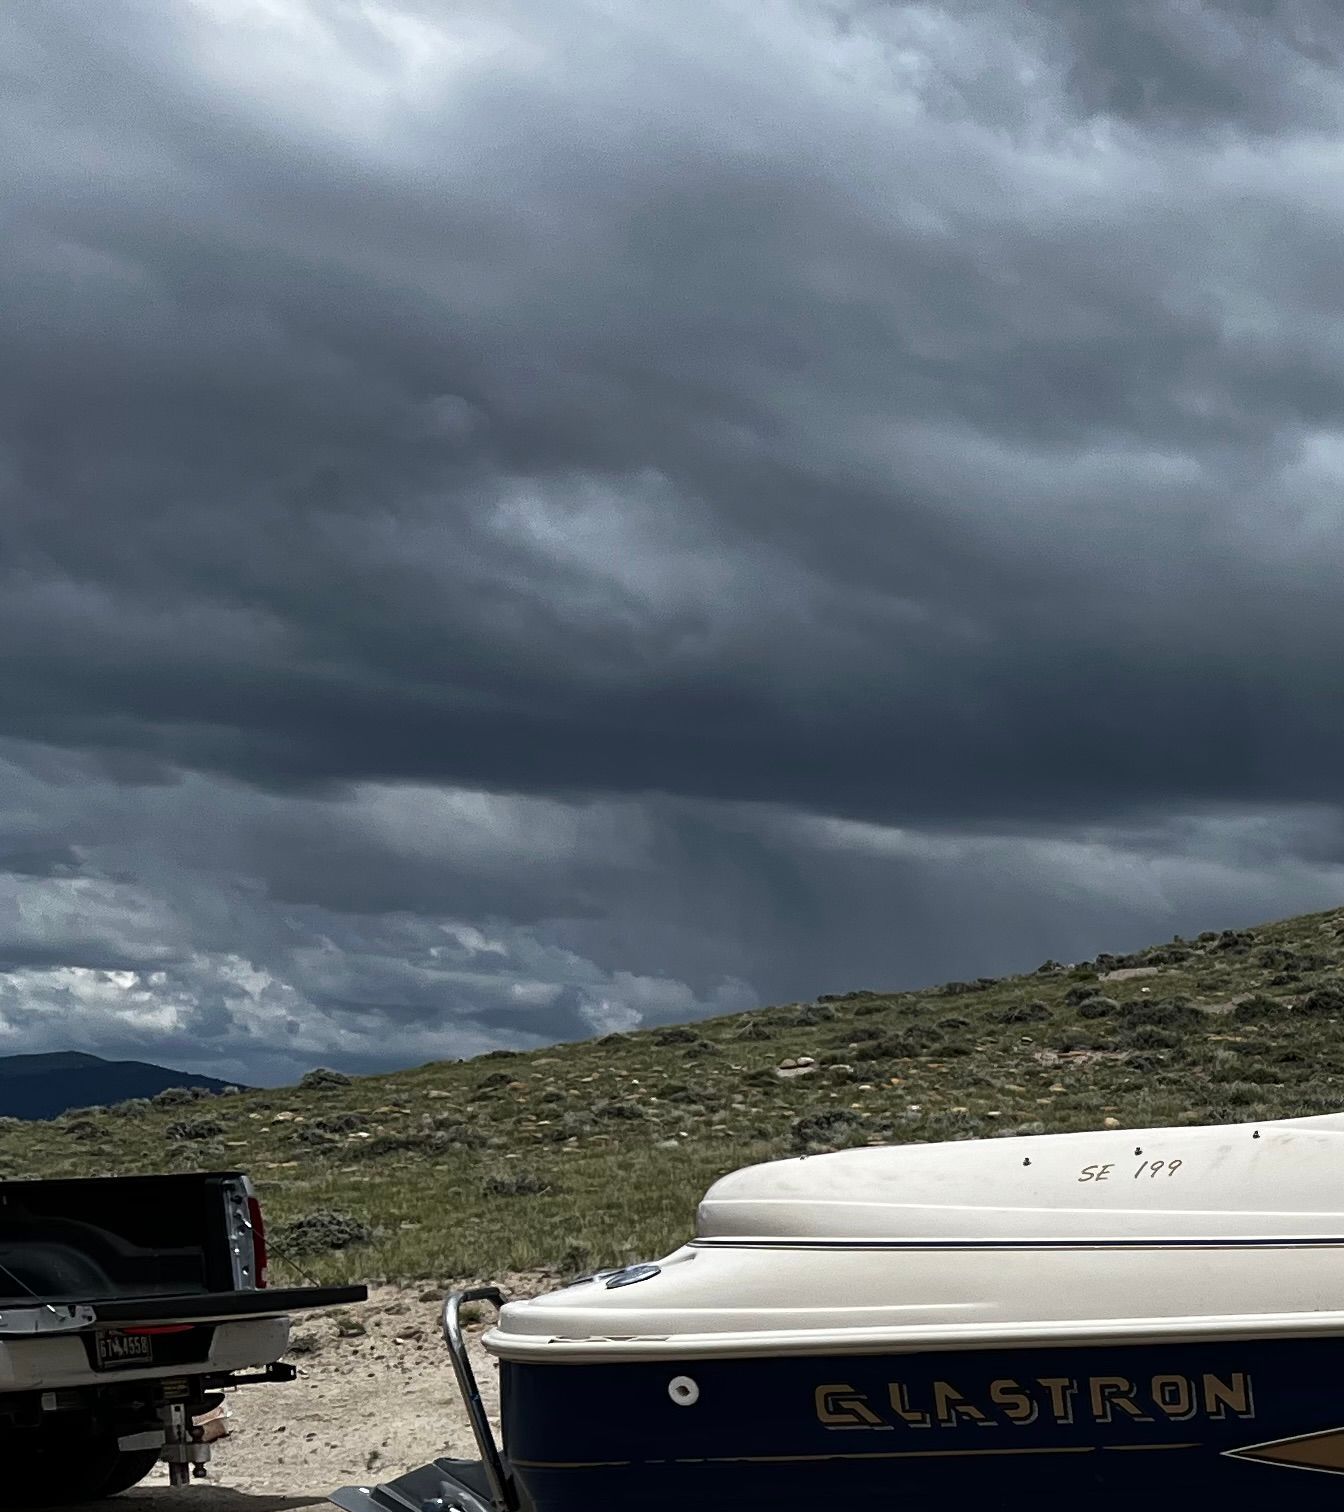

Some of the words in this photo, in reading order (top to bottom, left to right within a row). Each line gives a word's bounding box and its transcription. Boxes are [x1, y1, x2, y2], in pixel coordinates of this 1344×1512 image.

[1078, 1164, 1115, 1182] SE
[1134, 1160, 1182, 1179] 199
[814, 1373, 1256, 1431] GLASTRON
